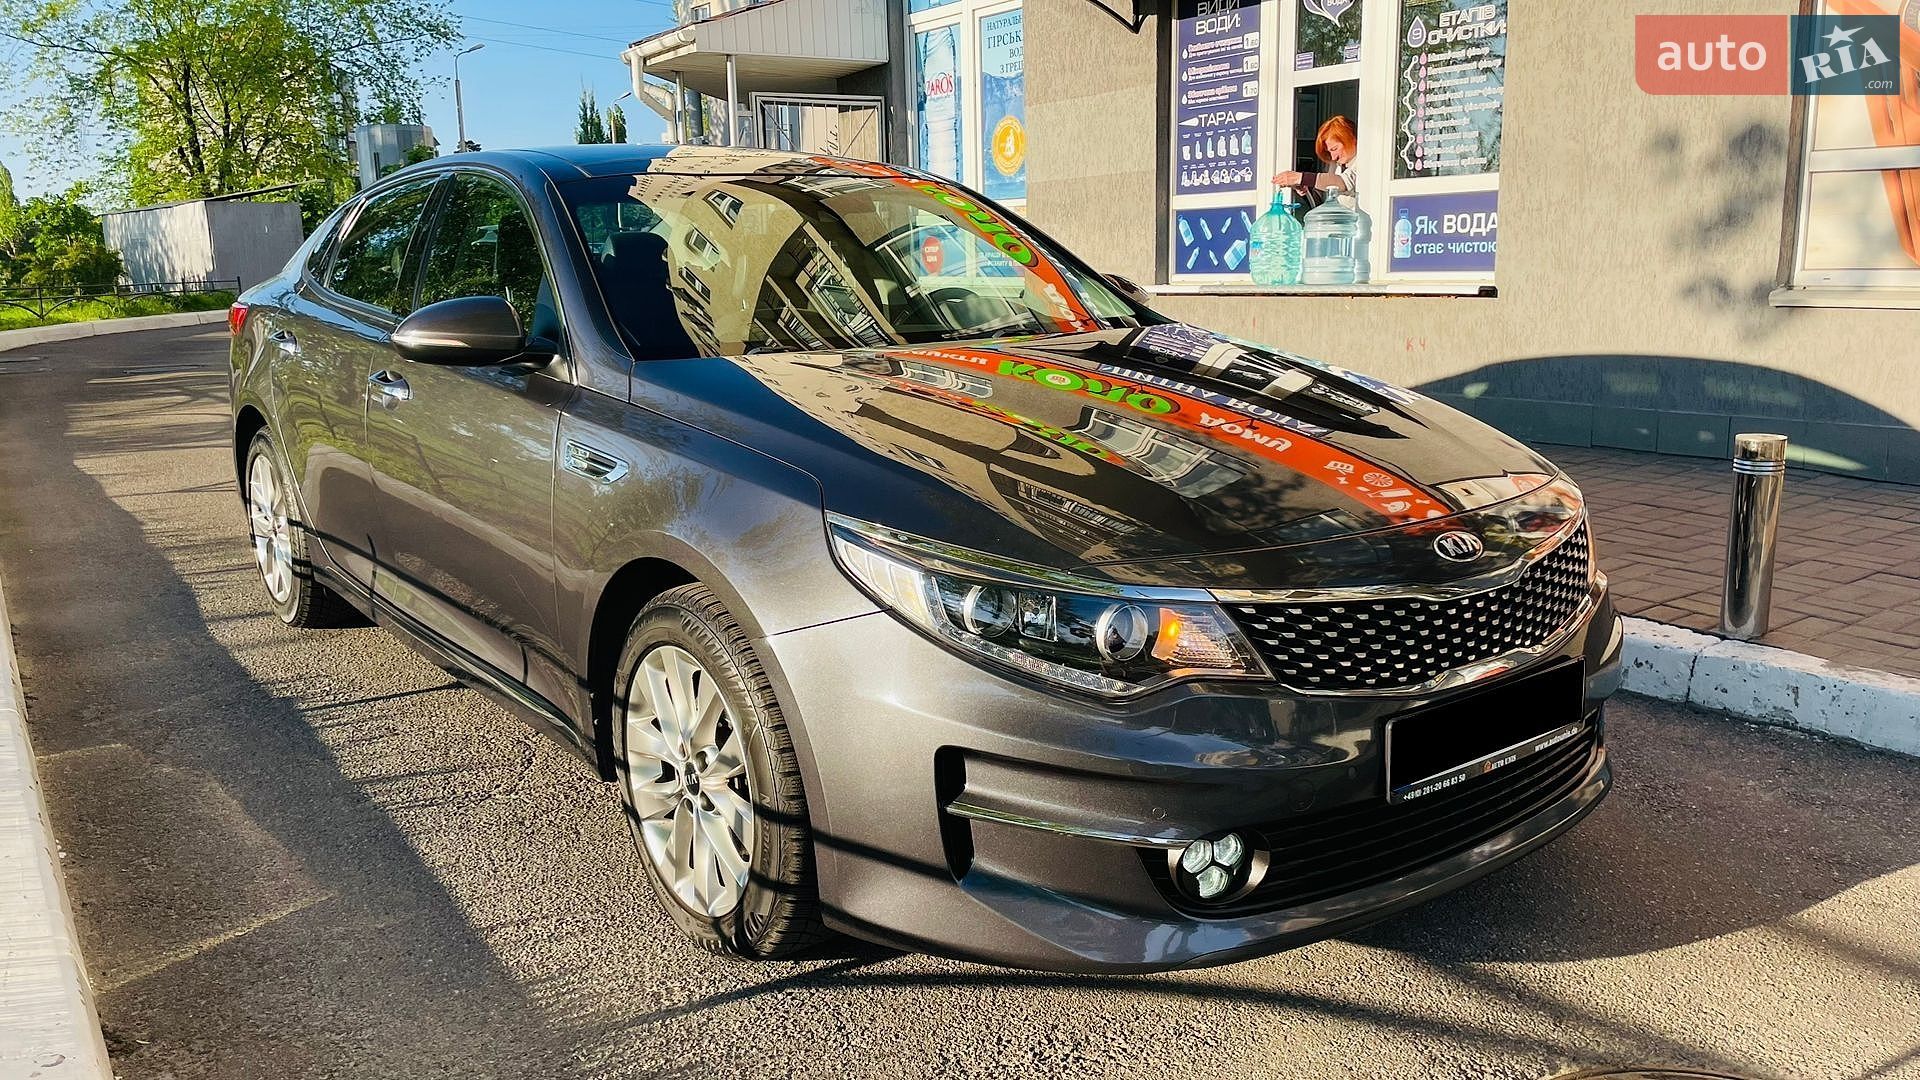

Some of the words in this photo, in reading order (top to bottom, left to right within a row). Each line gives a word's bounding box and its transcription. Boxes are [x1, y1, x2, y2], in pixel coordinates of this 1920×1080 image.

[1439, 5, 1496, 27] ЕТАПІВ
[1411, 28, 1422, 40] 9
[1198, 111, 1236, 127] ТАРА
[1415, 215, 1438, 235] Як
[1443, 211, 1498, 237] ВОДА
[1414, 242, 1444, 254] стає
[1439, 533, 1480, 557] KIA
